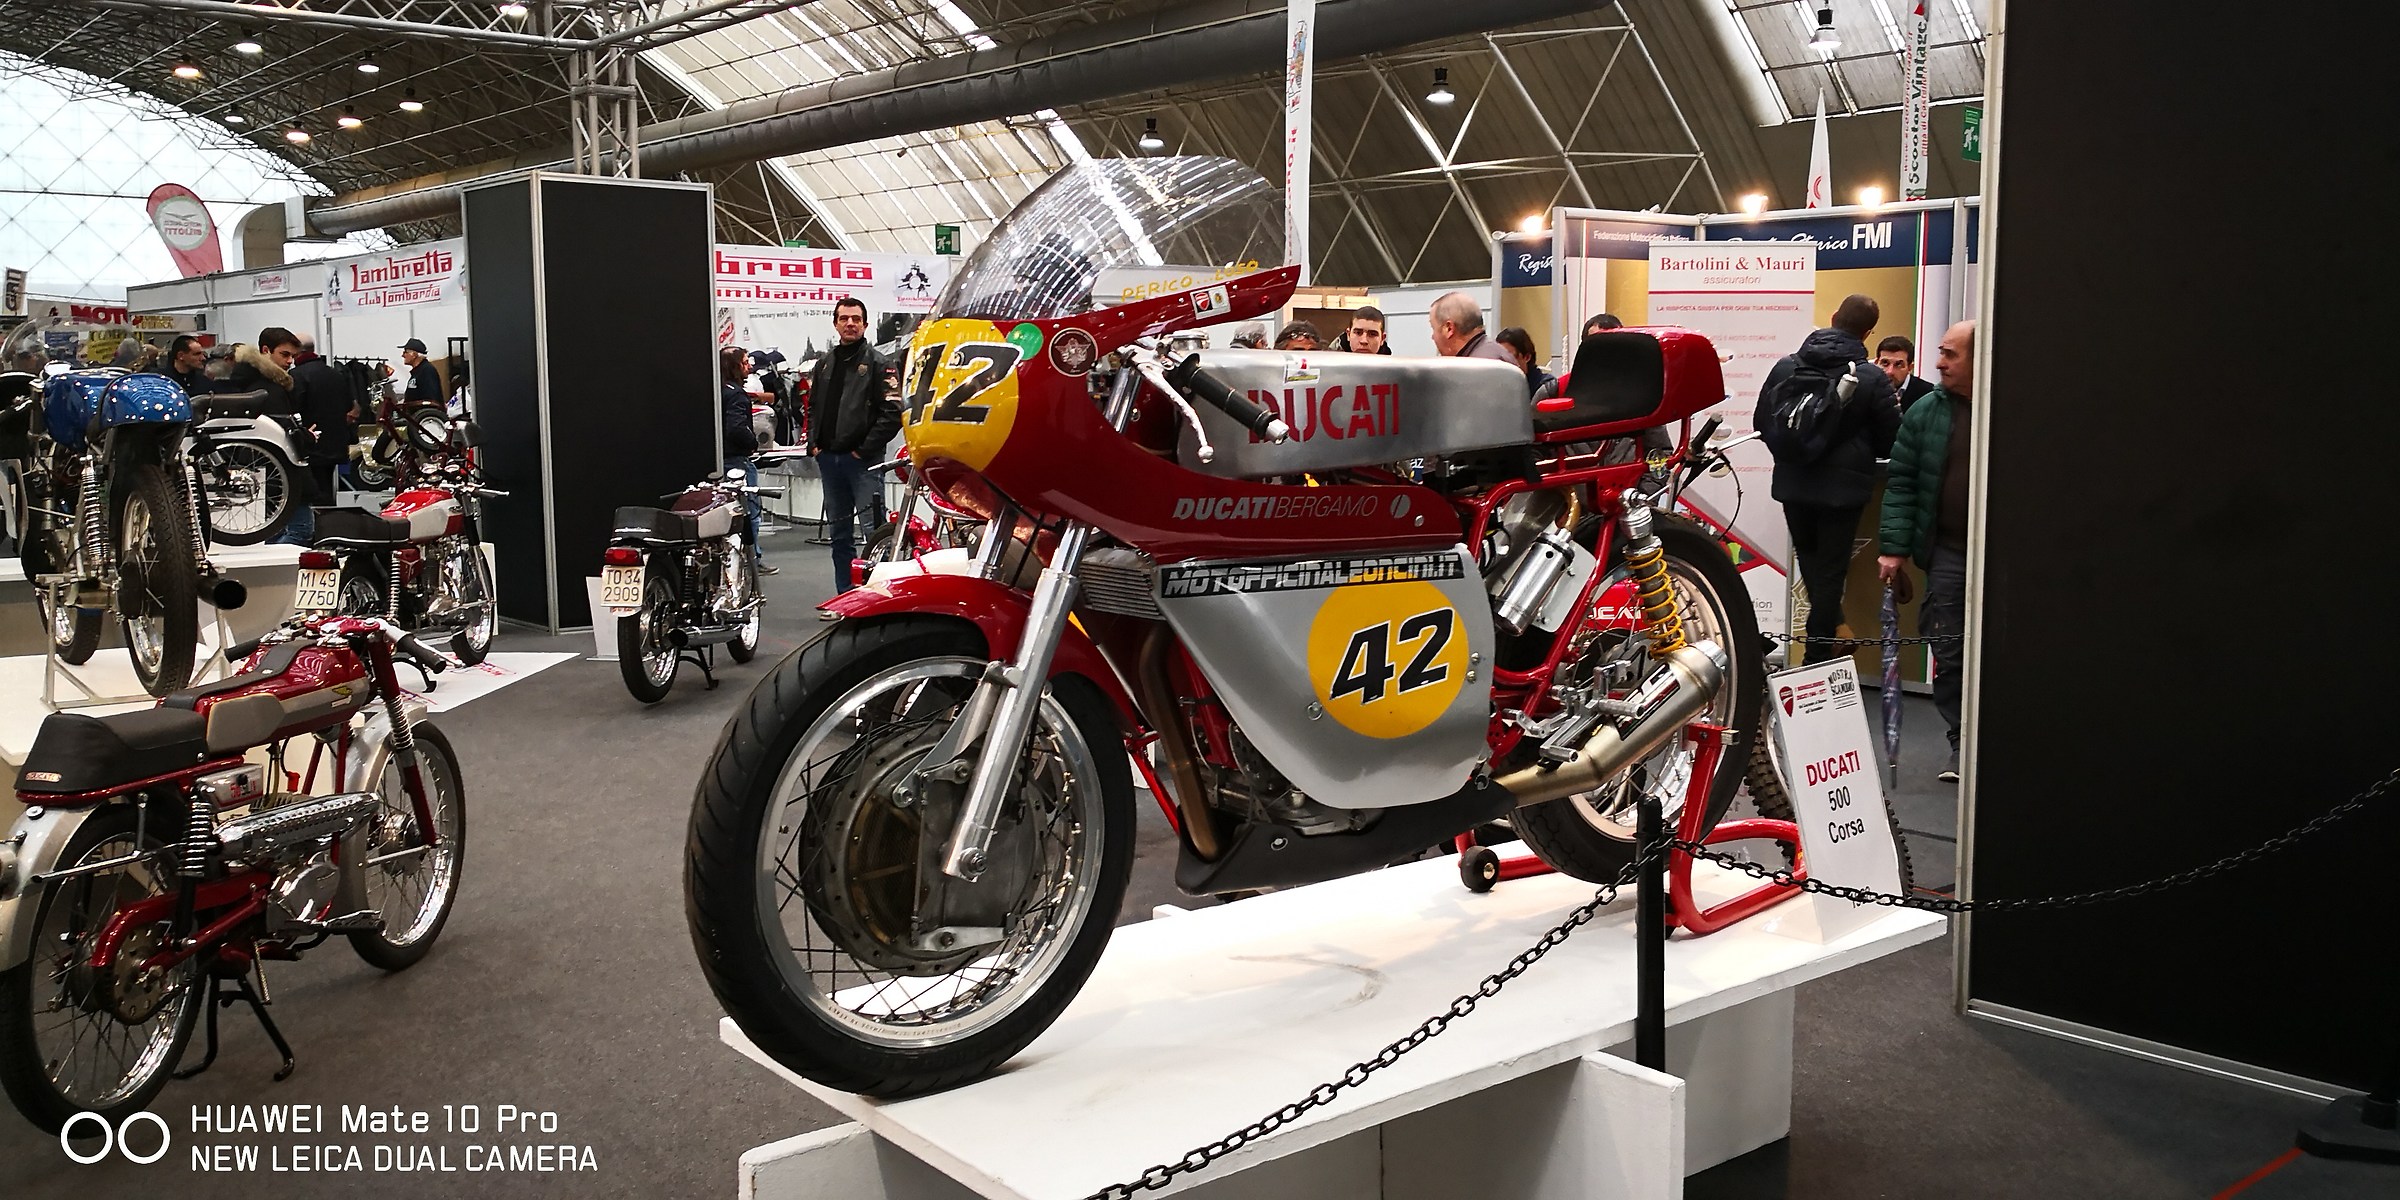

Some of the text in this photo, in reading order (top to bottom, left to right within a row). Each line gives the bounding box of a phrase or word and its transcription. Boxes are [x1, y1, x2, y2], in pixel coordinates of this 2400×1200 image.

[1908, 20, 1928, 184] Scooter Vintage
[1852, 222, 1892, 249] FMI
[350, 249, 452, 292] Lambretta
[715, 251, 873, 280] bretta
[1660, 256, 1805, 271] Bartolini & Mauri
[1703, 275, 1761, 284] assicuratori
[358, 290, 381, 306] club
[382, 283, 440, 307] Lombardia
[903, 341, 1024, 427] 42
[1248, 383, 1399, 444] DUCATI
[301, 572, 336, 588] MI 49
[625, 569, 640, 585] 34
[297, 590, 335, 607] 7750
[604, 586, 639, 602] 2909
[1330, 606, 1455, 706] 42
[1806, 750, 1860, 786] DUCATI
[1828, 786, 1850, 811] 500
[1828, 818, 1865, 843] Corsa
